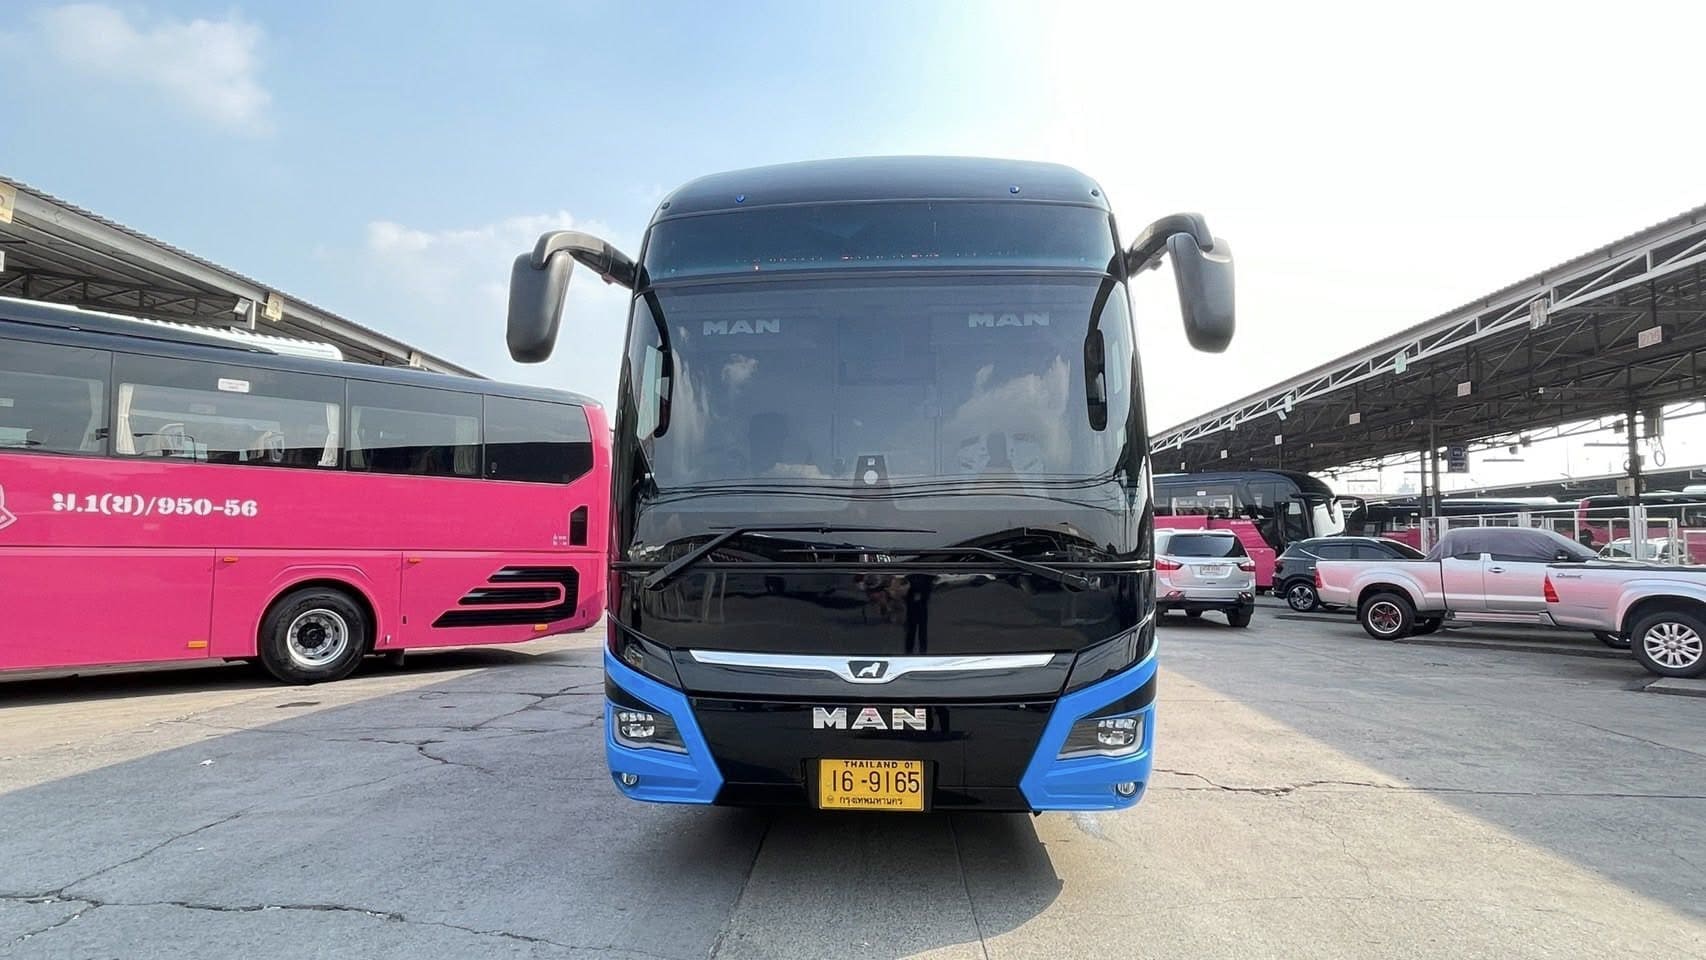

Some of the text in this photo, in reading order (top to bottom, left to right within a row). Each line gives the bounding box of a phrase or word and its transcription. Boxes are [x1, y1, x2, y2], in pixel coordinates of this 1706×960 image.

[703, 318, 781, 336] MAN
[968, 311, 1050, 328] MAN
[813, 707, 927, 730] MAN
[844, 760, 898, 769] THAILAND
[839, 796, 903, 806] กรุงเทพมหานคร
